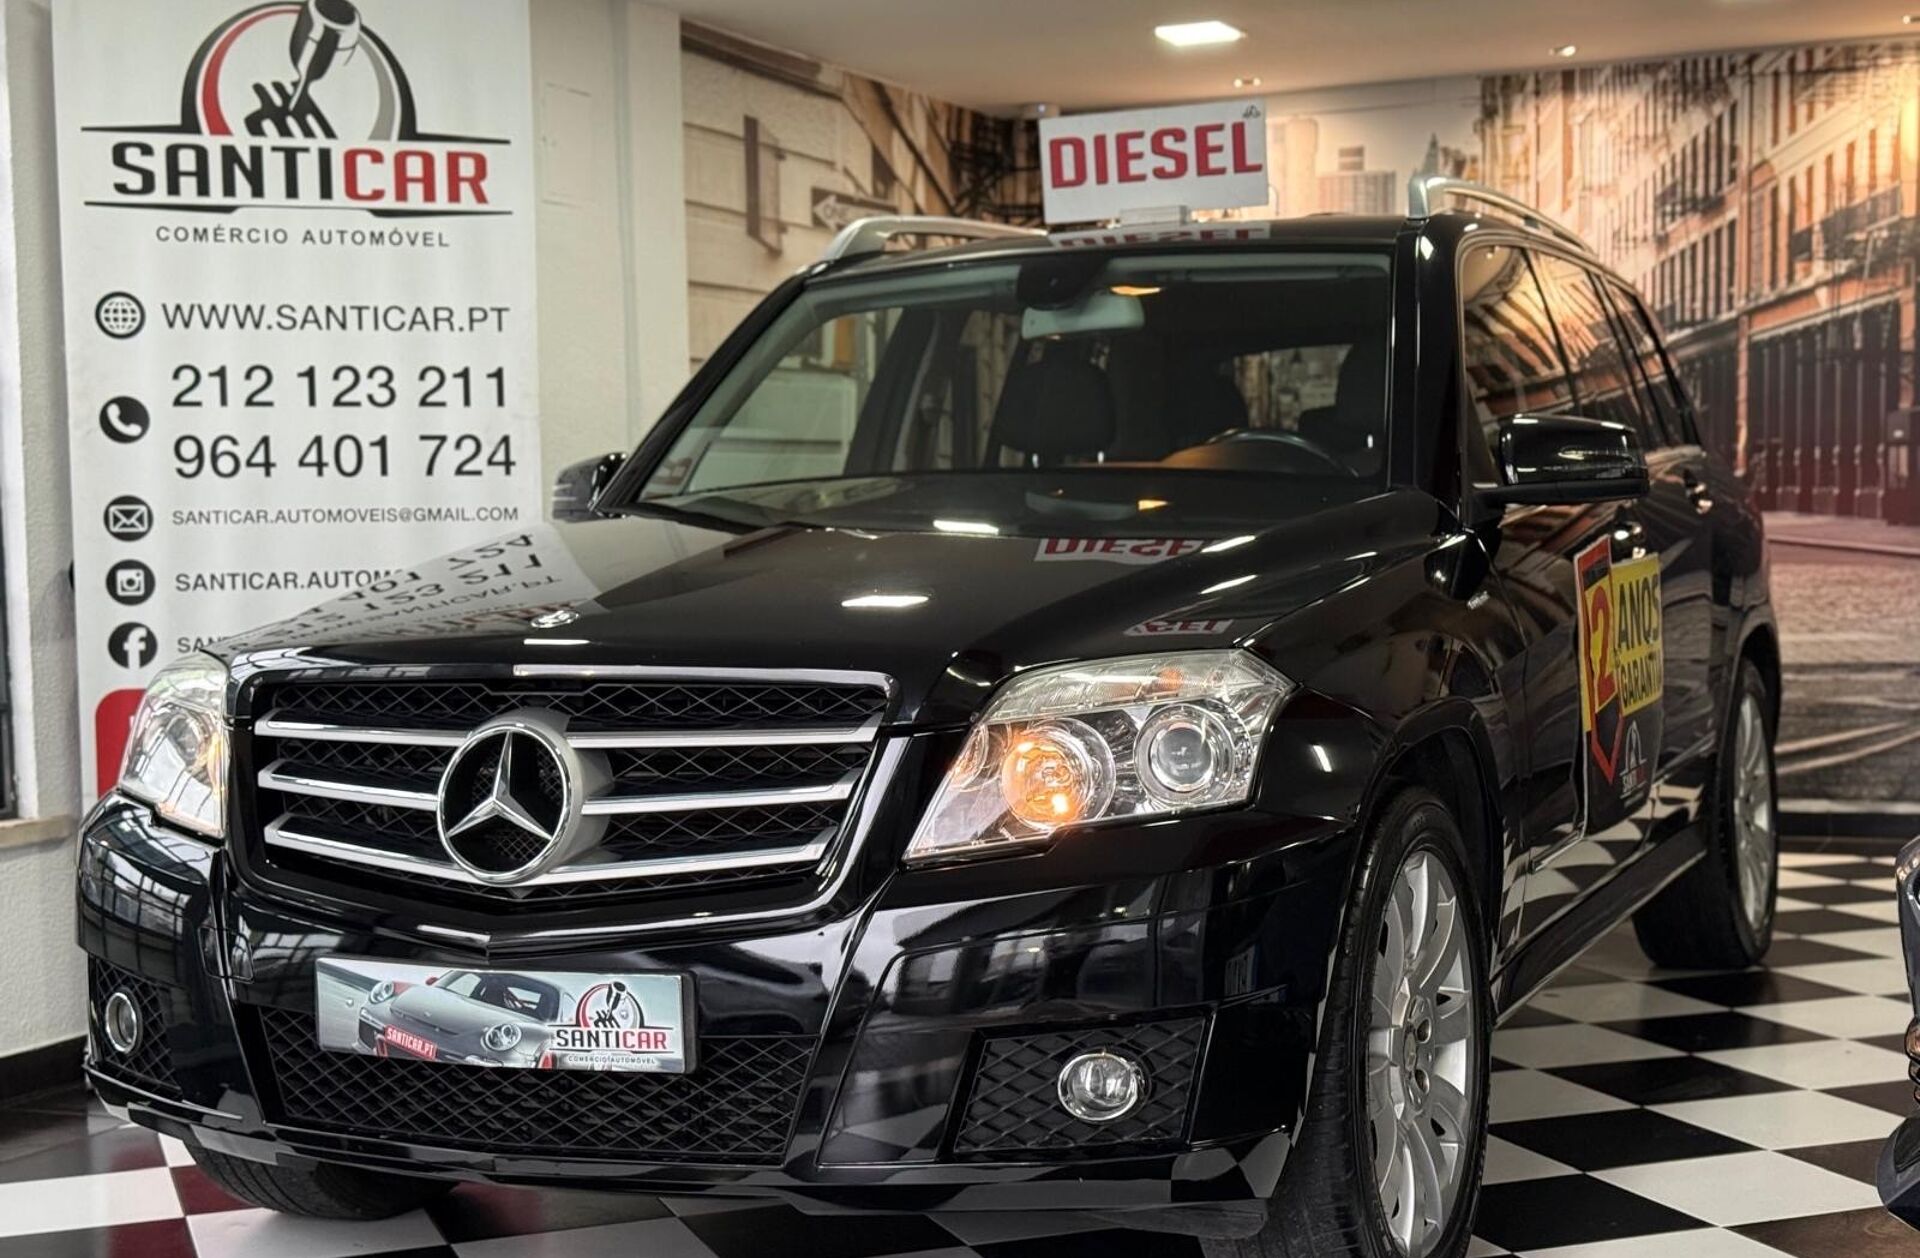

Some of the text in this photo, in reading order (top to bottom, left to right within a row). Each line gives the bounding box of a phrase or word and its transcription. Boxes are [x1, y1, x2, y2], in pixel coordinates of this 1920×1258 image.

[111, 141, 489, 204] SANTICAR
[1048, 121, 1264, 189] DIESEL
[155, 225, 451, 248] COMÉRCIO AUTOMÓVEL
[161, 303, 511, 332] WWW.SANTICAR.PT
[171, 364, 506, 408] 212 123 211
[173, 434, 517, 478] 964 401 724
[172, 506, 519, 526] SANTICAR.AUTOMOVEIS@GMAIL.COM
[175, 570, 402, 592] SANTICAR.AUTO
[1617, 574, 1660, 650] ANOS
[1591, 585, 1616, 706] 2
[556, 1028, 667, 1050] SANTICAR
